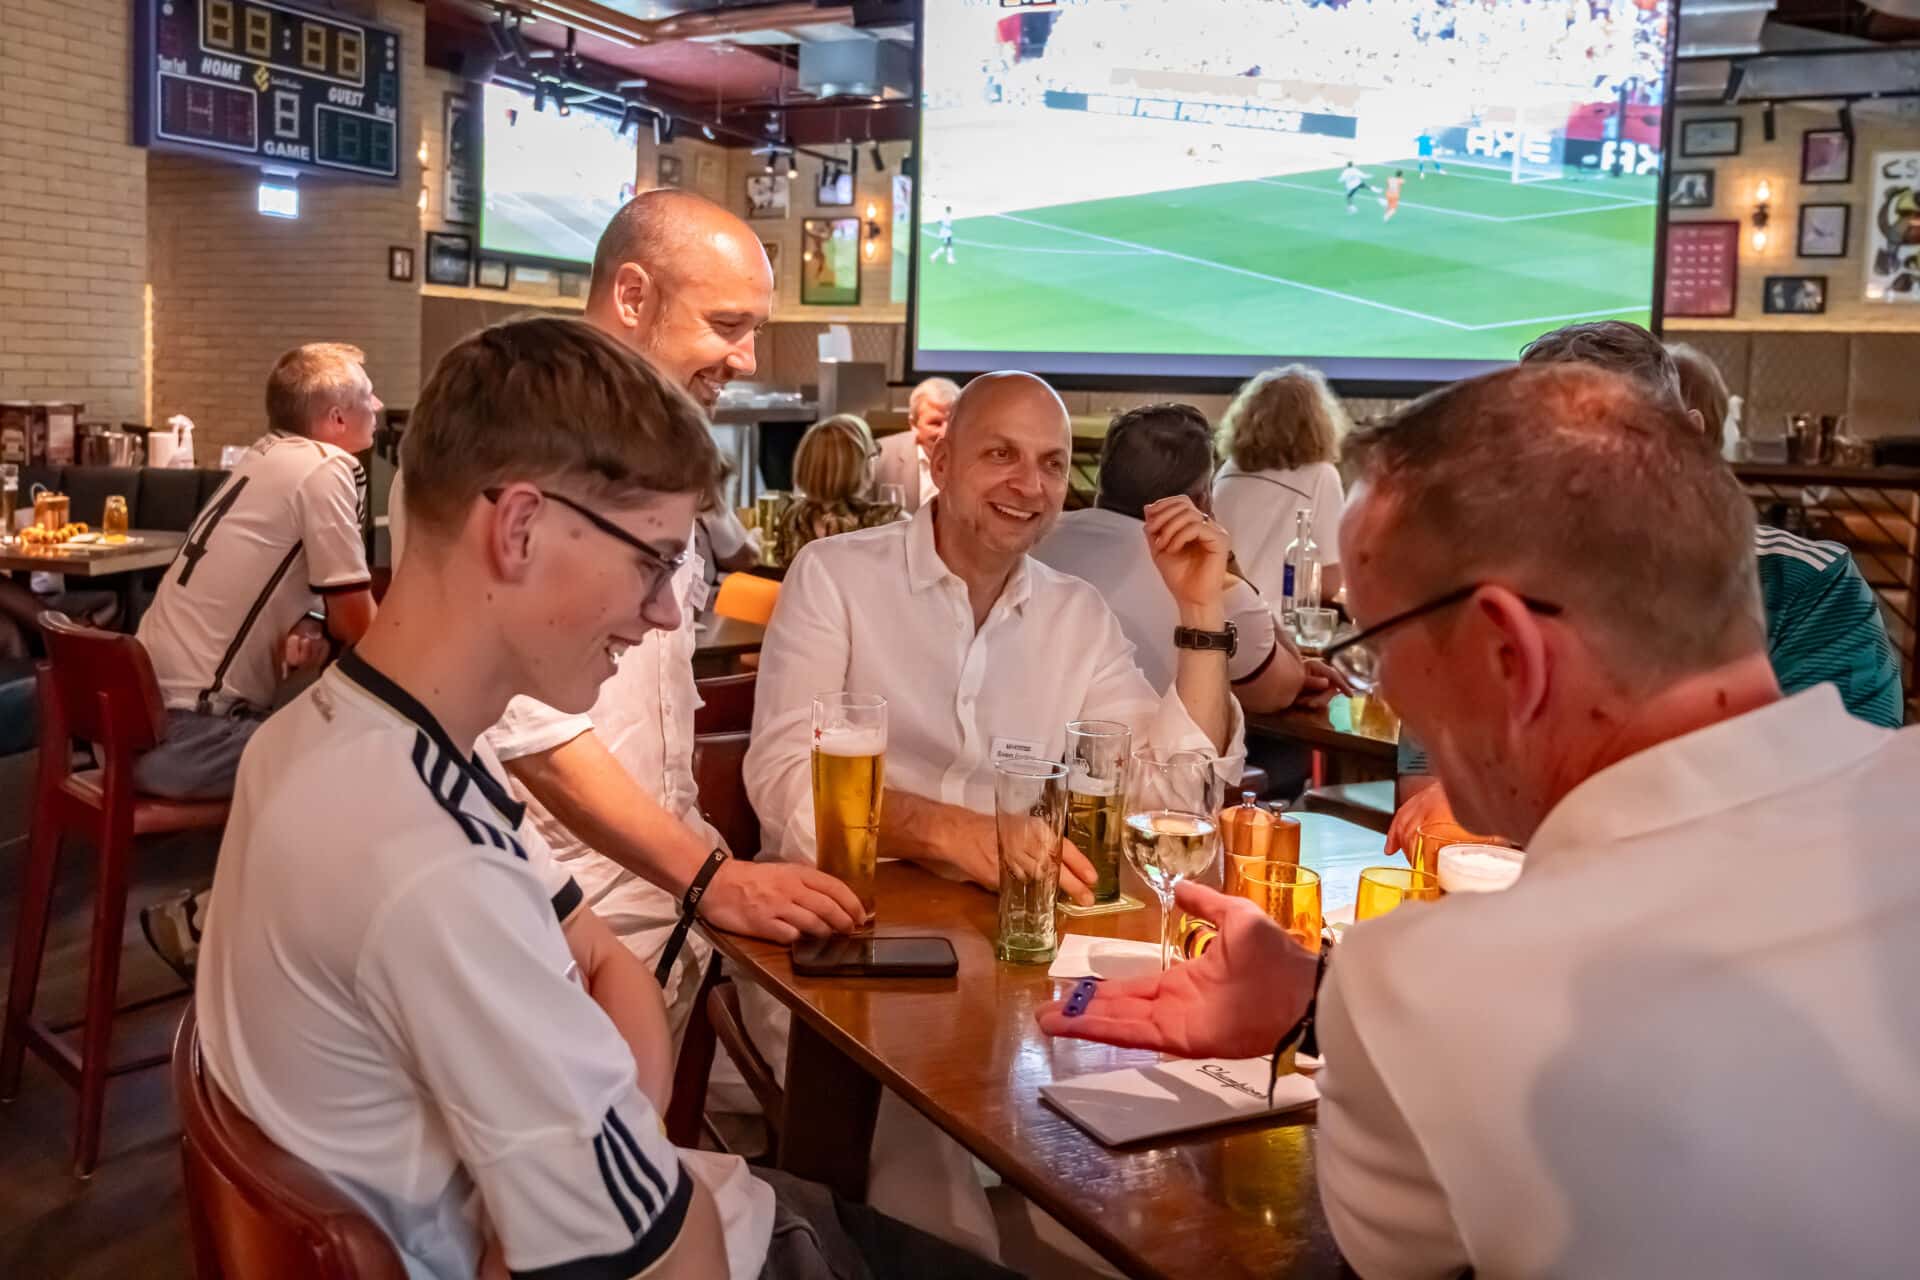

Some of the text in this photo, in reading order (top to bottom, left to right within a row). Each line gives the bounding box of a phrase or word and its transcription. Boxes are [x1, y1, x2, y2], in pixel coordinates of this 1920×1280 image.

[201, 57, 242, 80] HOME
[328, 87, 365, 106] GUEST
[263, 140, 310, 161] GAME
[1467, 128, 1551, 163] AXE
[177, 475, 250, 588] 4
